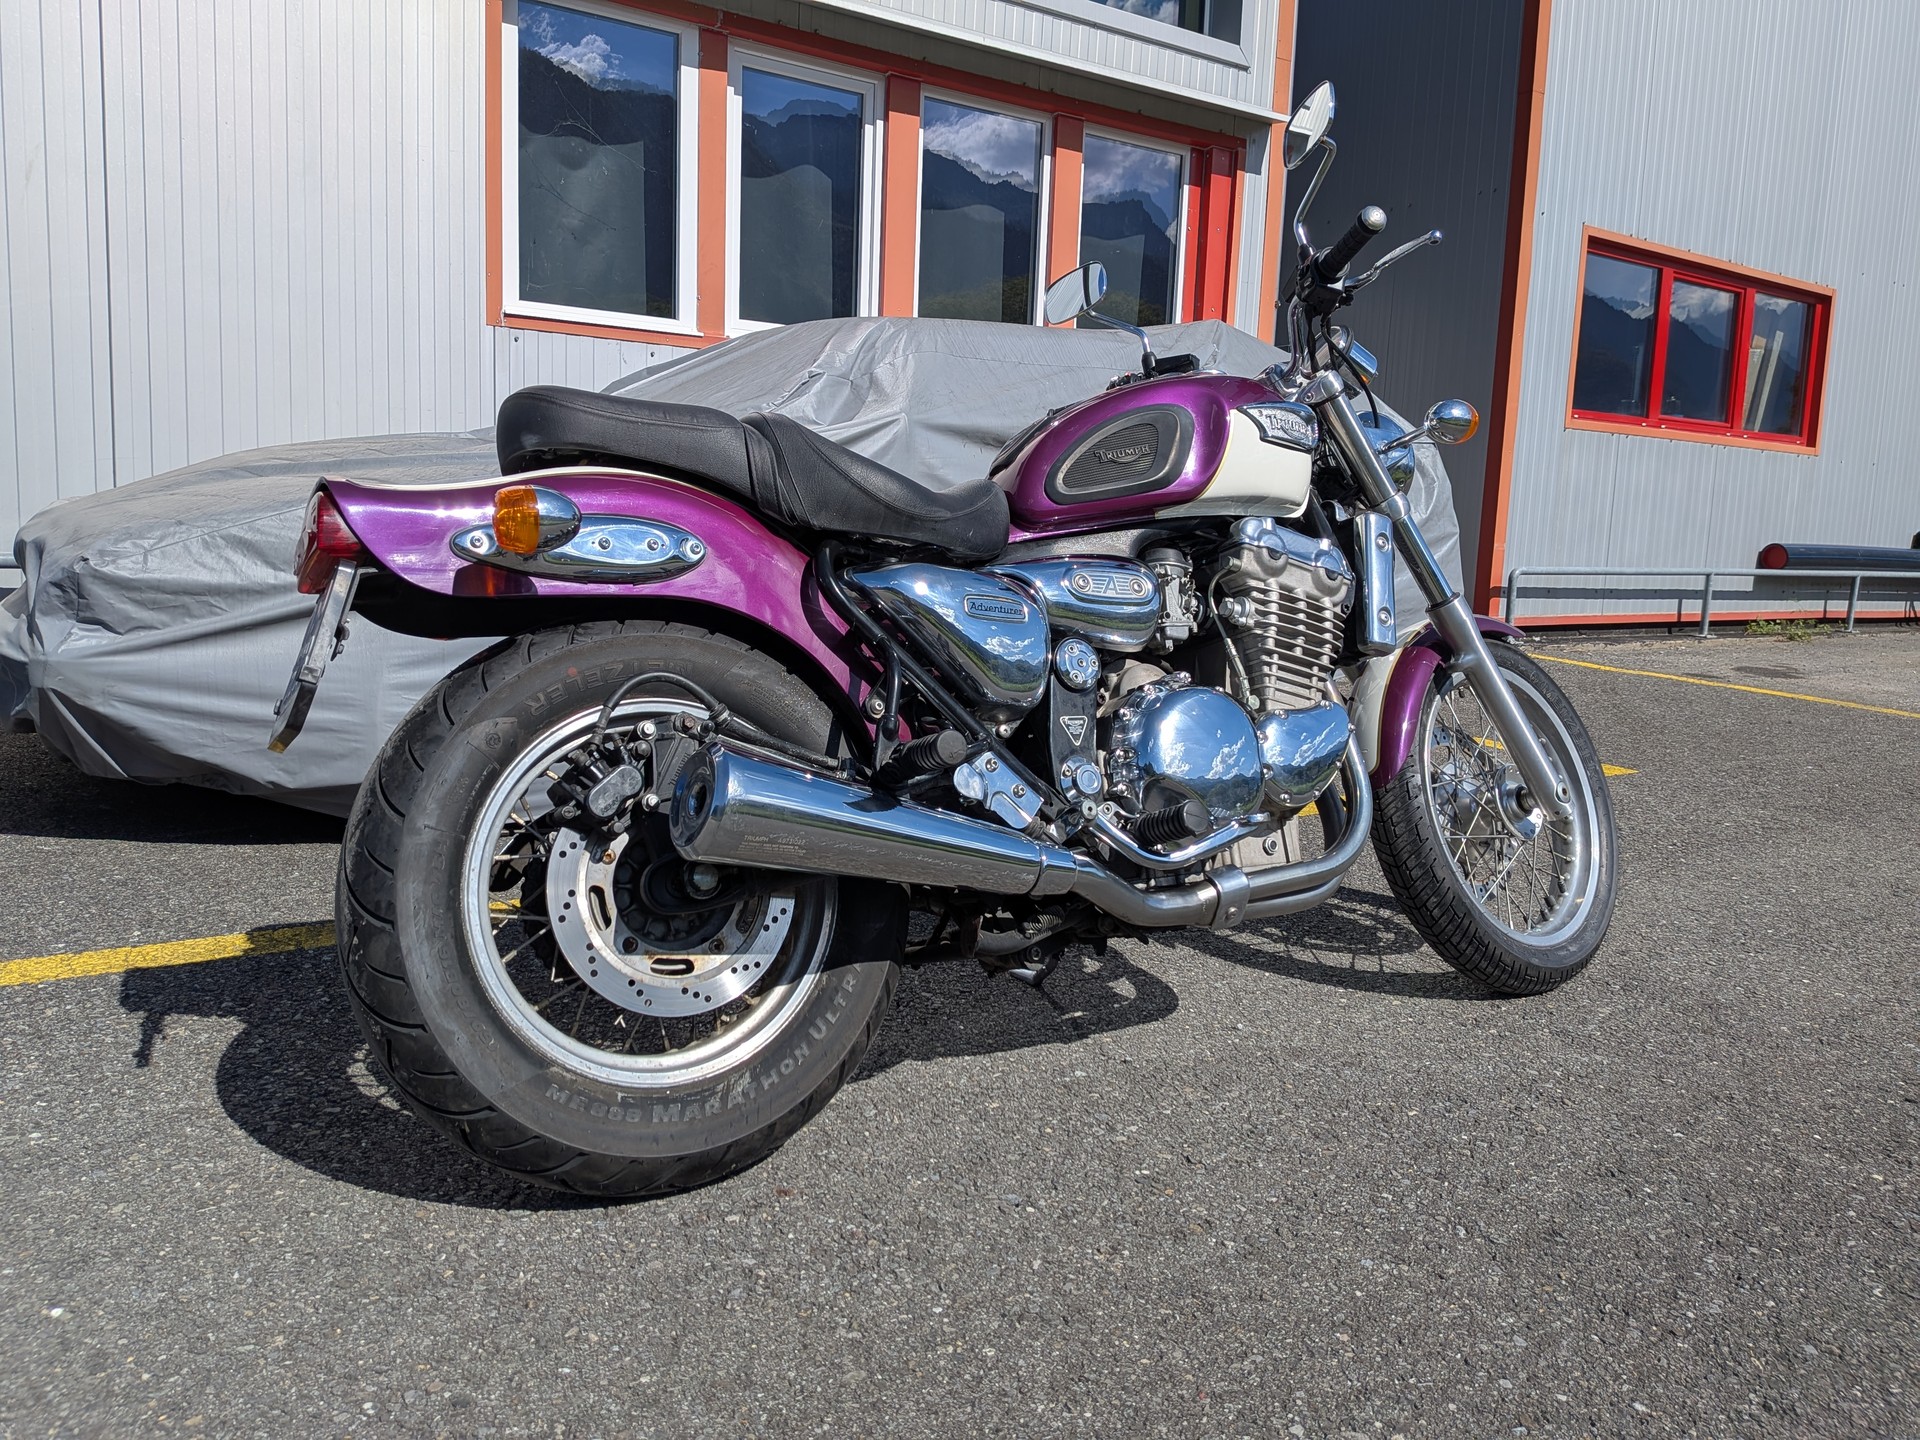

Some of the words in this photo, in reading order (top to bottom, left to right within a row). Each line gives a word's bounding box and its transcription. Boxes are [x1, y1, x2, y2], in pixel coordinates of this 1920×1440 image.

[1094, 444, 1151, 463] TRIUMPH
[969, 601, 1023, 616] Adventurer
[652, 1045, 810, 1123] MARATHON
